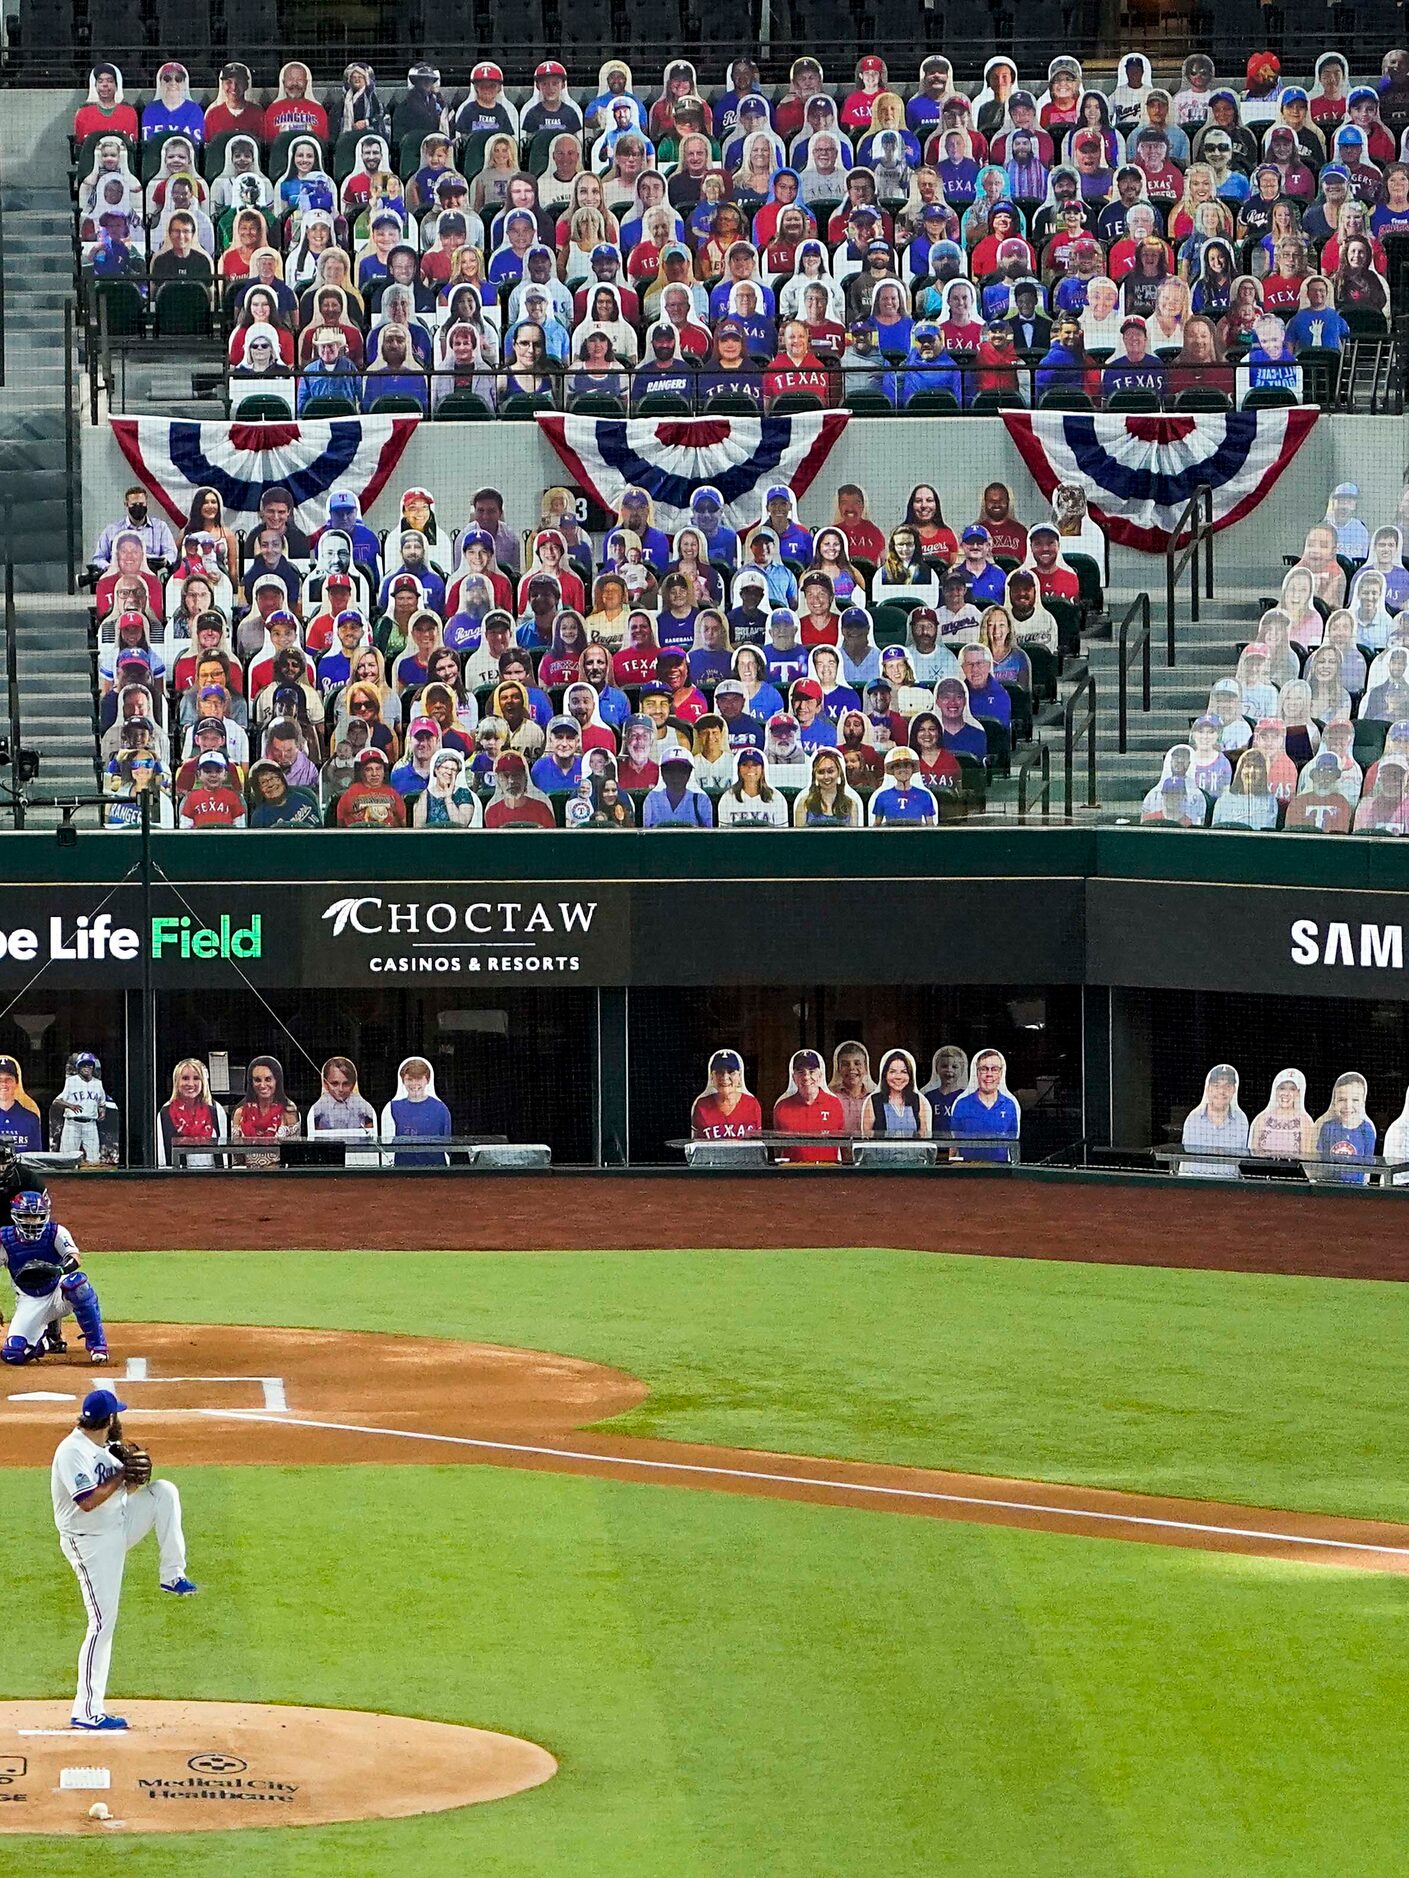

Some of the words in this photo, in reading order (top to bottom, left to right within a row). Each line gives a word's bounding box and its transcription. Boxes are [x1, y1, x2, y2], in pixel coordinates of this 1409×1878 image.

[482, 68, 490, 76] T
[684, 99, 692, 107] T
[748, 99, 756, 107] T
[274, 115, 318, 126] RANGERS
[1166, 175, 1174, 183] T
[1292, 174, 1300, 183] T
[828, 335, 841, 350] T
[647, 379, 686, 392] RANGERS
[774, 373, 826, 388] TEXAS
[1112, 374, 1163, 390] TEXAS
[576, 498, 588, 521] 3
[642, 548, 653, 561] T
[789, 543, 798, 554] T
[335, 575, 342, 584] T
[132, 648, 140, 656] T
[562, 670, 572, 681] T
[770, 662, 799, 682] T
[690, 704, 702, 715] T
[673, 748, 680, 756] T
[898, 798, 908, 810] T
[1305, 804, 1338, 828] T
[349, 897, 598, 934] CHOCTAW
[50, 914, 140, 960] Life
[150, 914, 262, 958] Field
[1291, 920, 1404, 968] SAM
[370, 958, 461, 972] CASINOS
[468, 958, 481, 970] &
[488, 956, 580, 971] RESORTS
[821, 1112, 830, 1121] T
[139, 1778, 243, 1789] Medical
[247, 1780, 300, 1794] City
[149, 1790, 294, 1802] Healthcare
